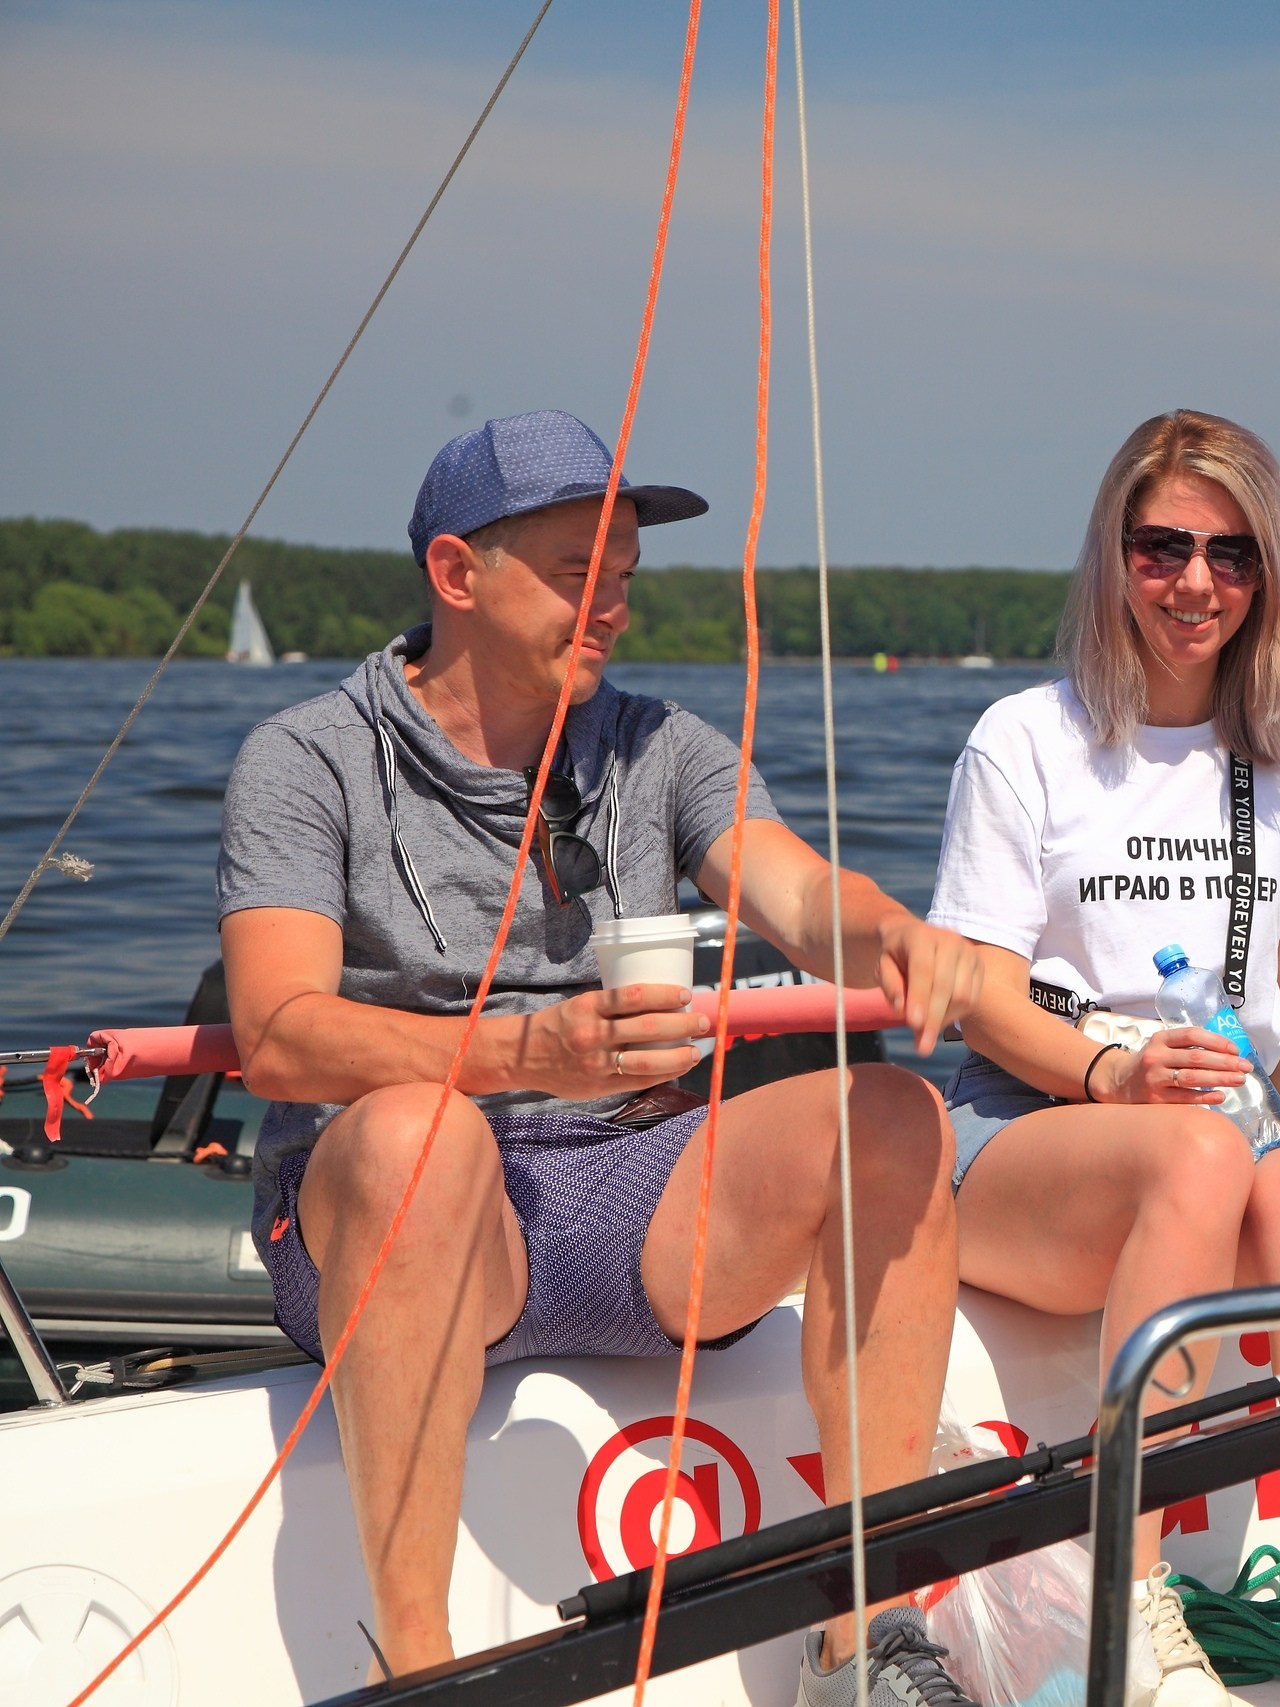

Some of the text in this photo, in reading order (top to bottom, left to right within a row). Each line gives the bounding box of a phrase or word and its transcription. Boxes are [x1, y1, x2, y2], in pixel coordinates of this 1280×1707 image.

[1235, 797, 1252, 856] YOUNG
[1127, 836, 1234, 861] ОТЛИЧН
[1079, 875, 1278, 903] ИГРАЮ В ПОЕР
[1231, 872, 1252, 960] FOREVER
